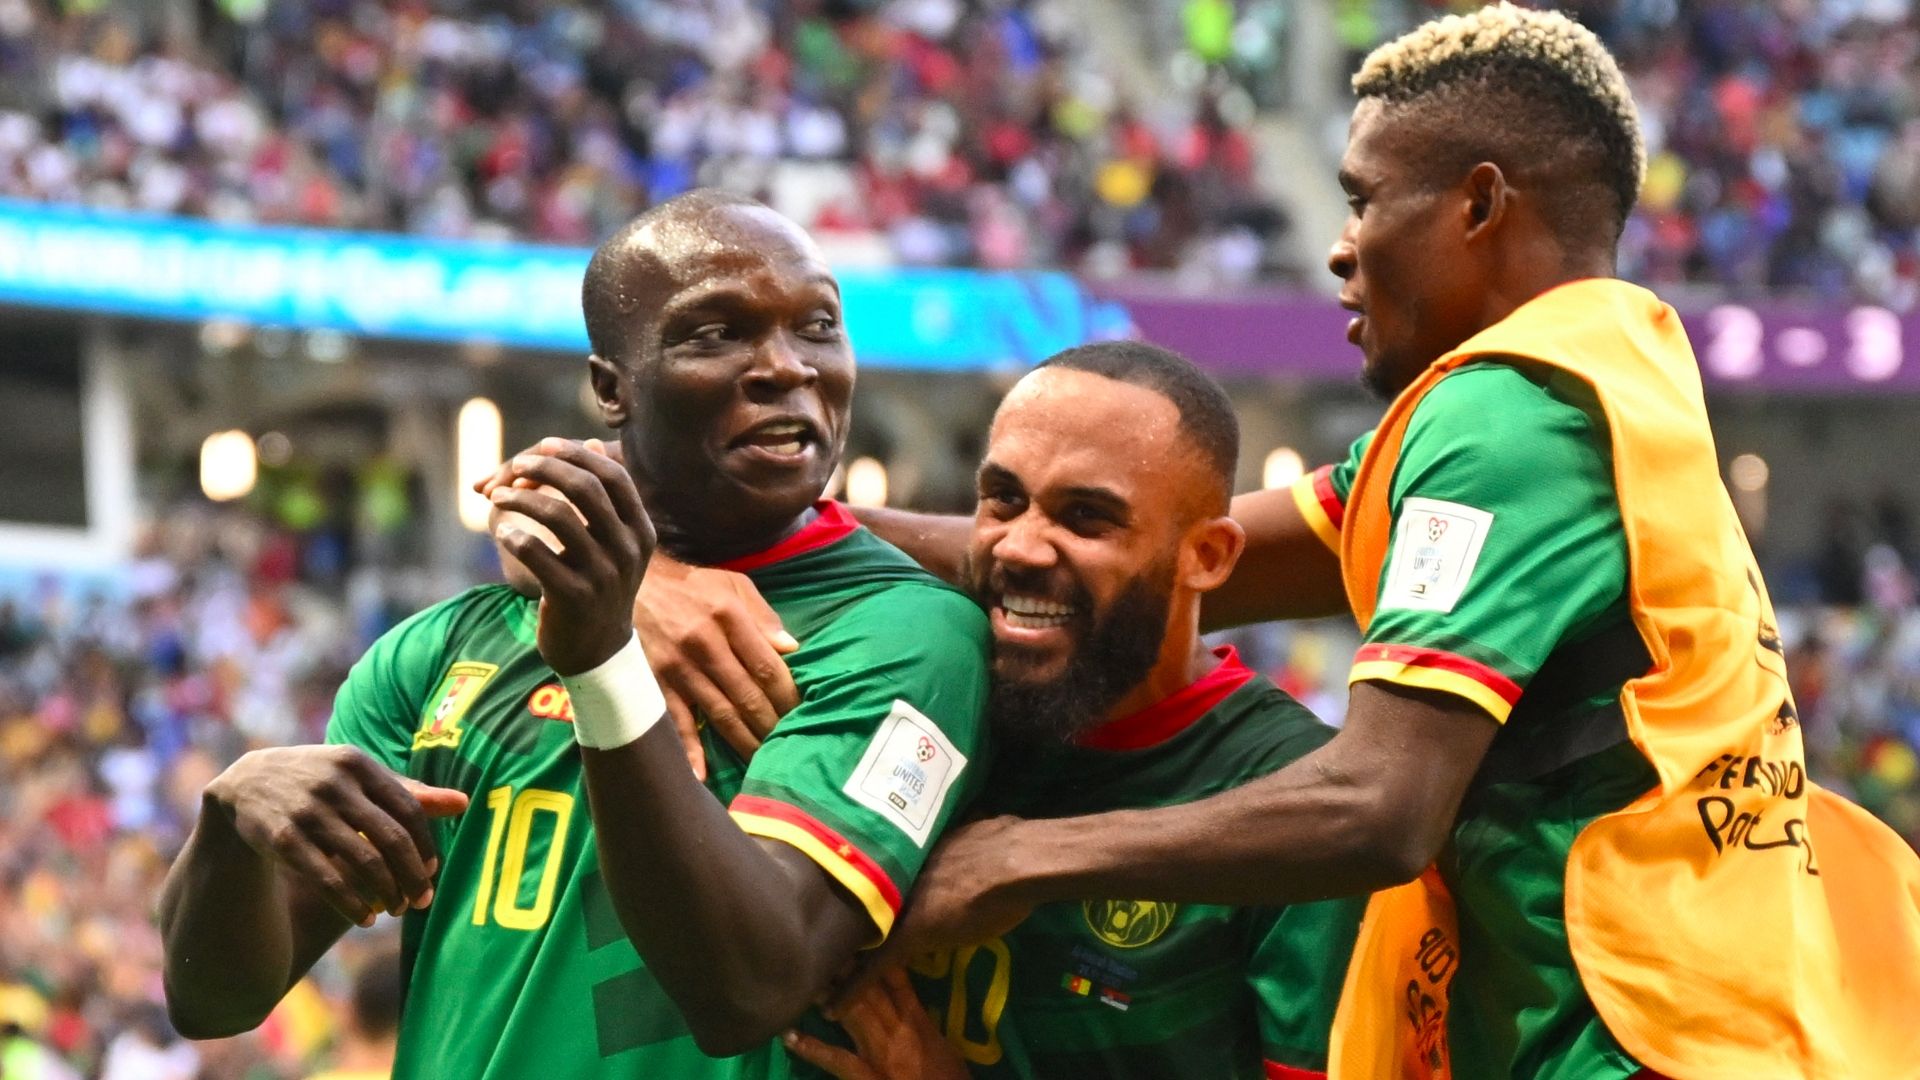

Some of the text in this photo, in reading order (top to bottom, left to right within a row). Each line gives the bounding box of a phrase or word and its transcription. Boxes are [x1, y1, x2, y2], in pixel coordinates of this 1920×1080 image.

[892, 764, 925, 796] UNITES
[471, 785, 574, 931] 10
[908, 938, 1011, 1065] 0
